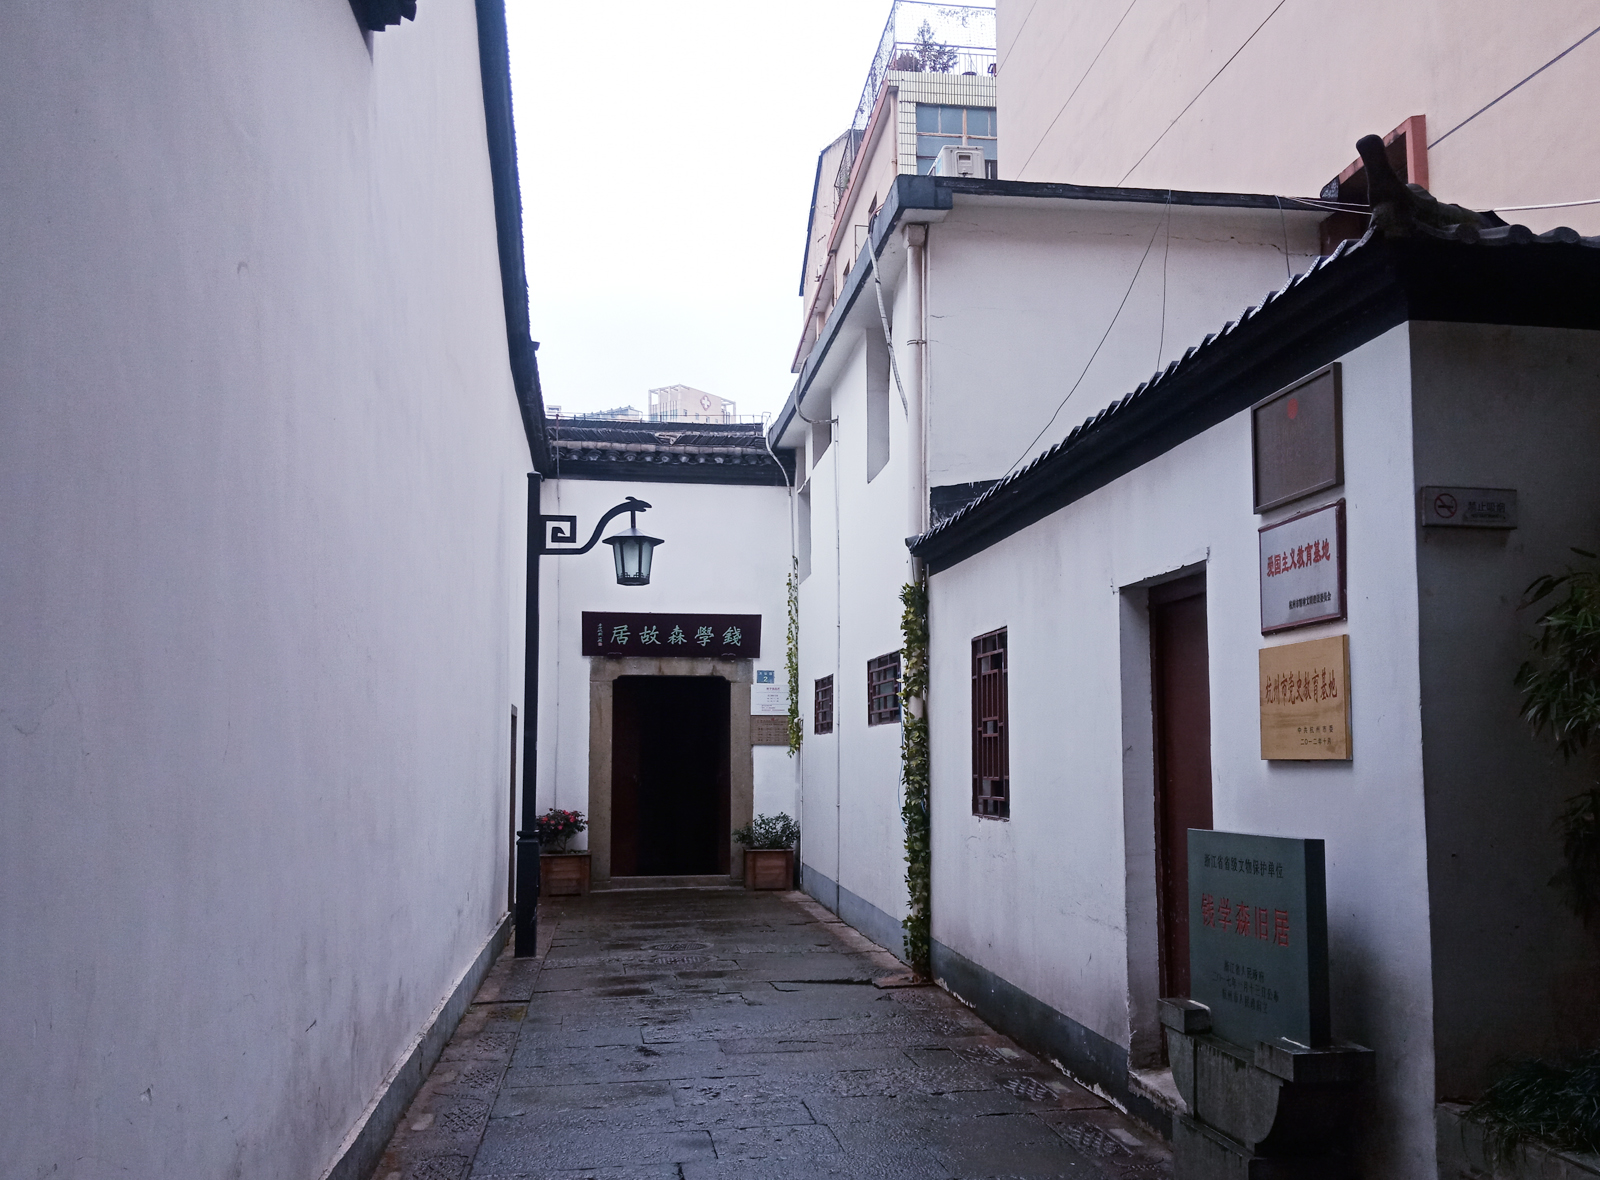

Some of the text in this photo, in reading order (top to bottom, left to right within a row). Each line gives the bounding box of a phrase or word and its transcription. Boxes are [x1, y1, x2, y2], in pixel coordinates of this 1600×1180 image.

[1267, 538, 1331, 577] 爱国主义教育基地
[610, 624, 742, 647] 錢學森故居
[1265, 667, 1338, 706] 杭州市党史教育基地
[1297, 725, 1333, 734] 中共杭州市委
[1204, 854, 1283, 878] 浙江省省级文物保护单位
[1201, 893, 1290, 947] 钱学森旧居
